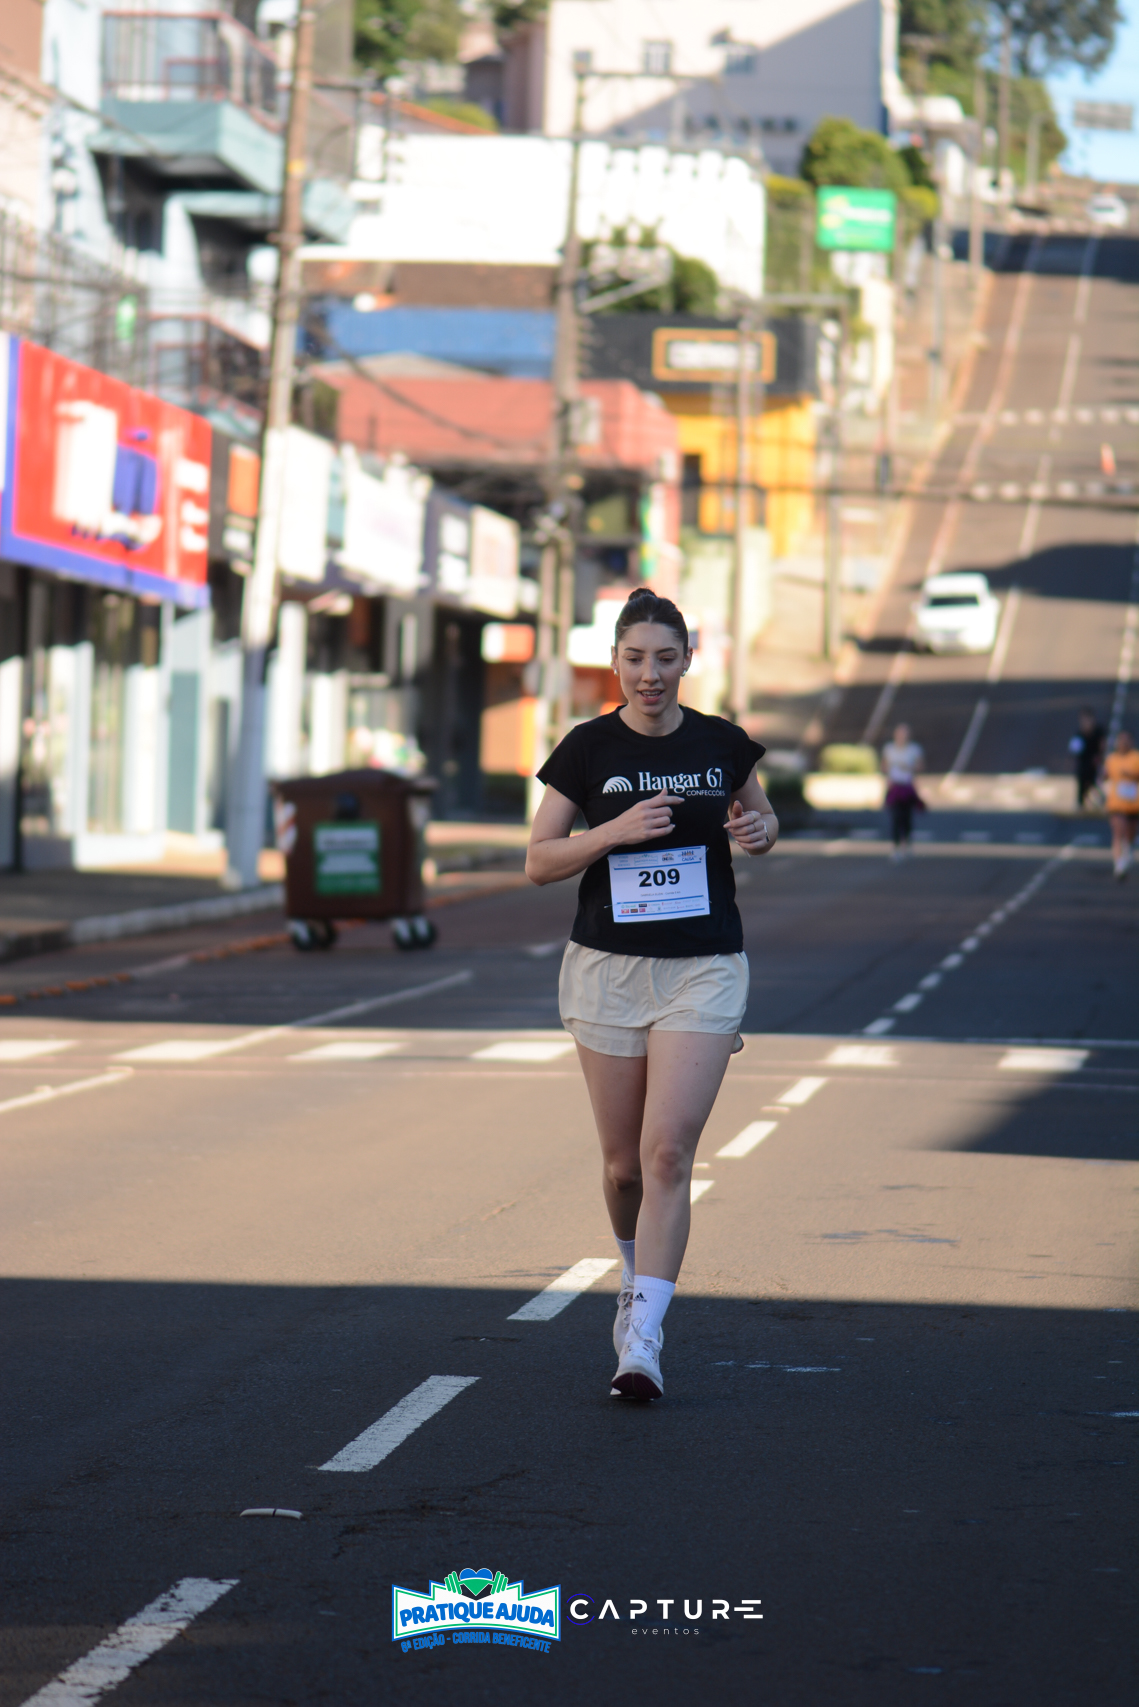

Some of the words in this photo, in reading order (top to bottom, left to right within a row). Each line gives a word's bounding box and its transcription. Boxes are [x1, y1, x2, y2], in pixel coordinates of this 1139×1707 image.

[638, 771, 702, 794] Hangar
[706, 767, 723, 788] 67
[686, 789, 726, 797] CONFECÇÕES
[638, 867, 680, 887] 209
